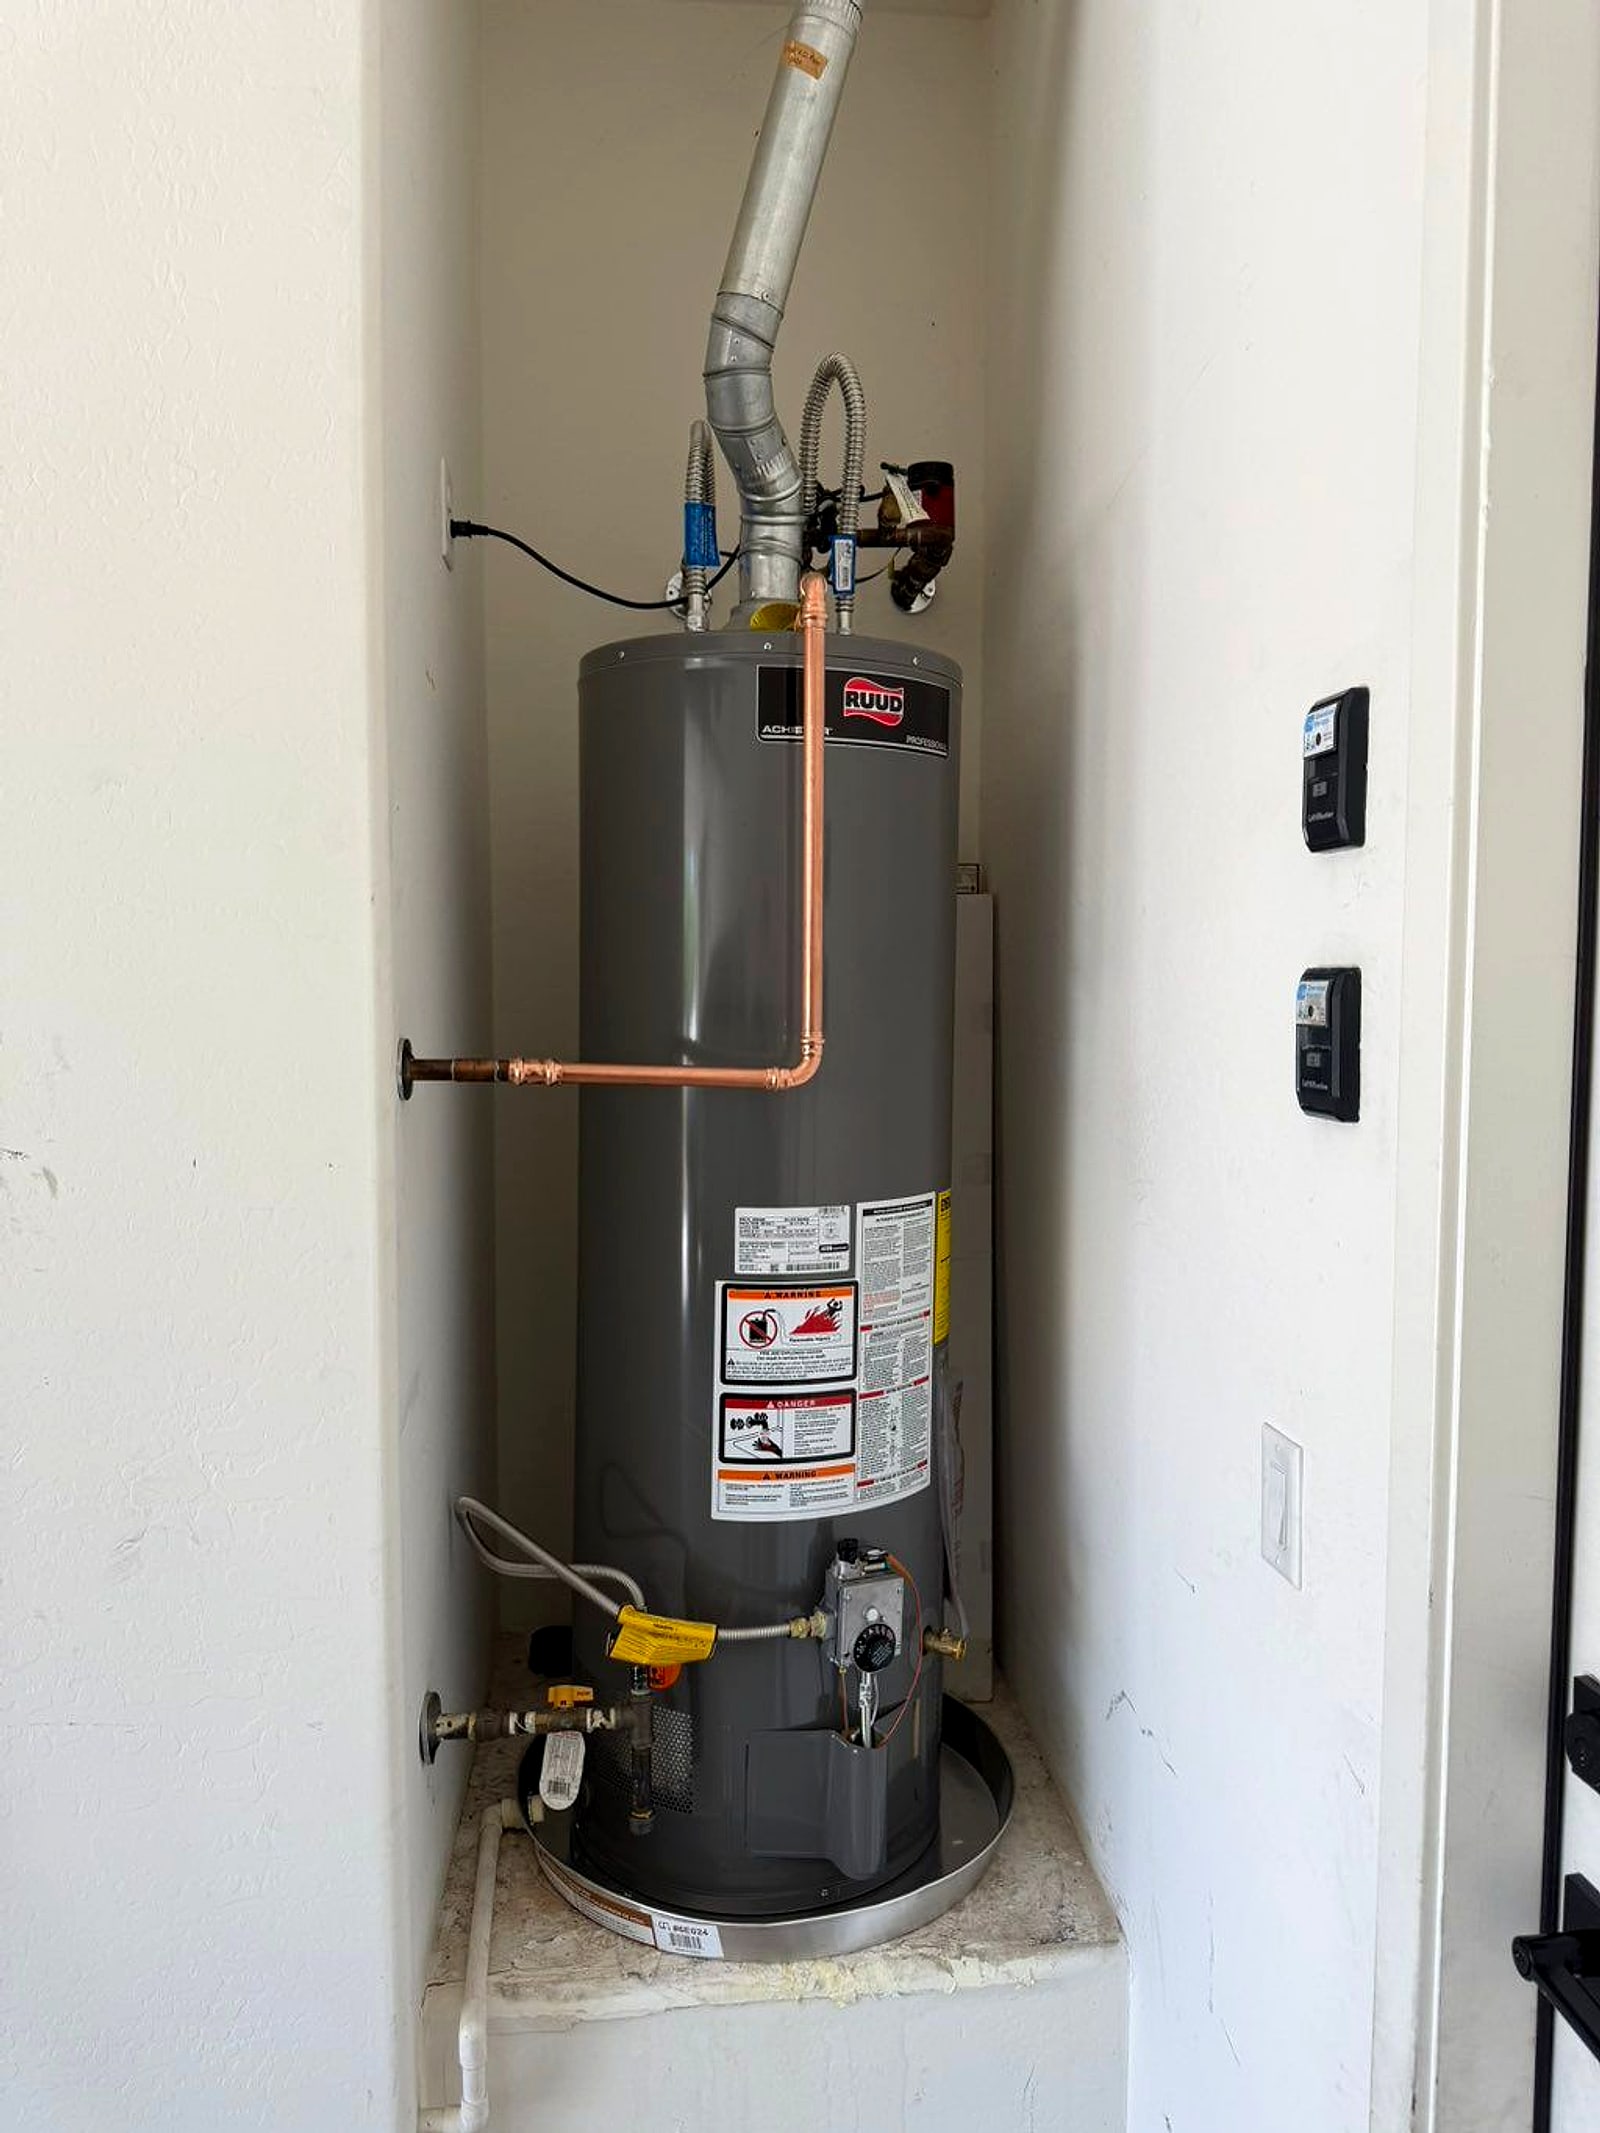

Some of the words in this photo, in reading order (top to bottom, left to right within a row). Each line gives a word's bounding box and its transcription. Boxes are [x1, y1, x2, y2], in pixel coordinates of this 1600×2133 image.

[845, 690, 901, 712] RUUD
[762, 724, 830, 736] ACHIER
[775, 1290, 821, 1299] WARNING
[776, 1399, 816, 1408] DANGER
[775, 1470, 817, 1479] WARNING
